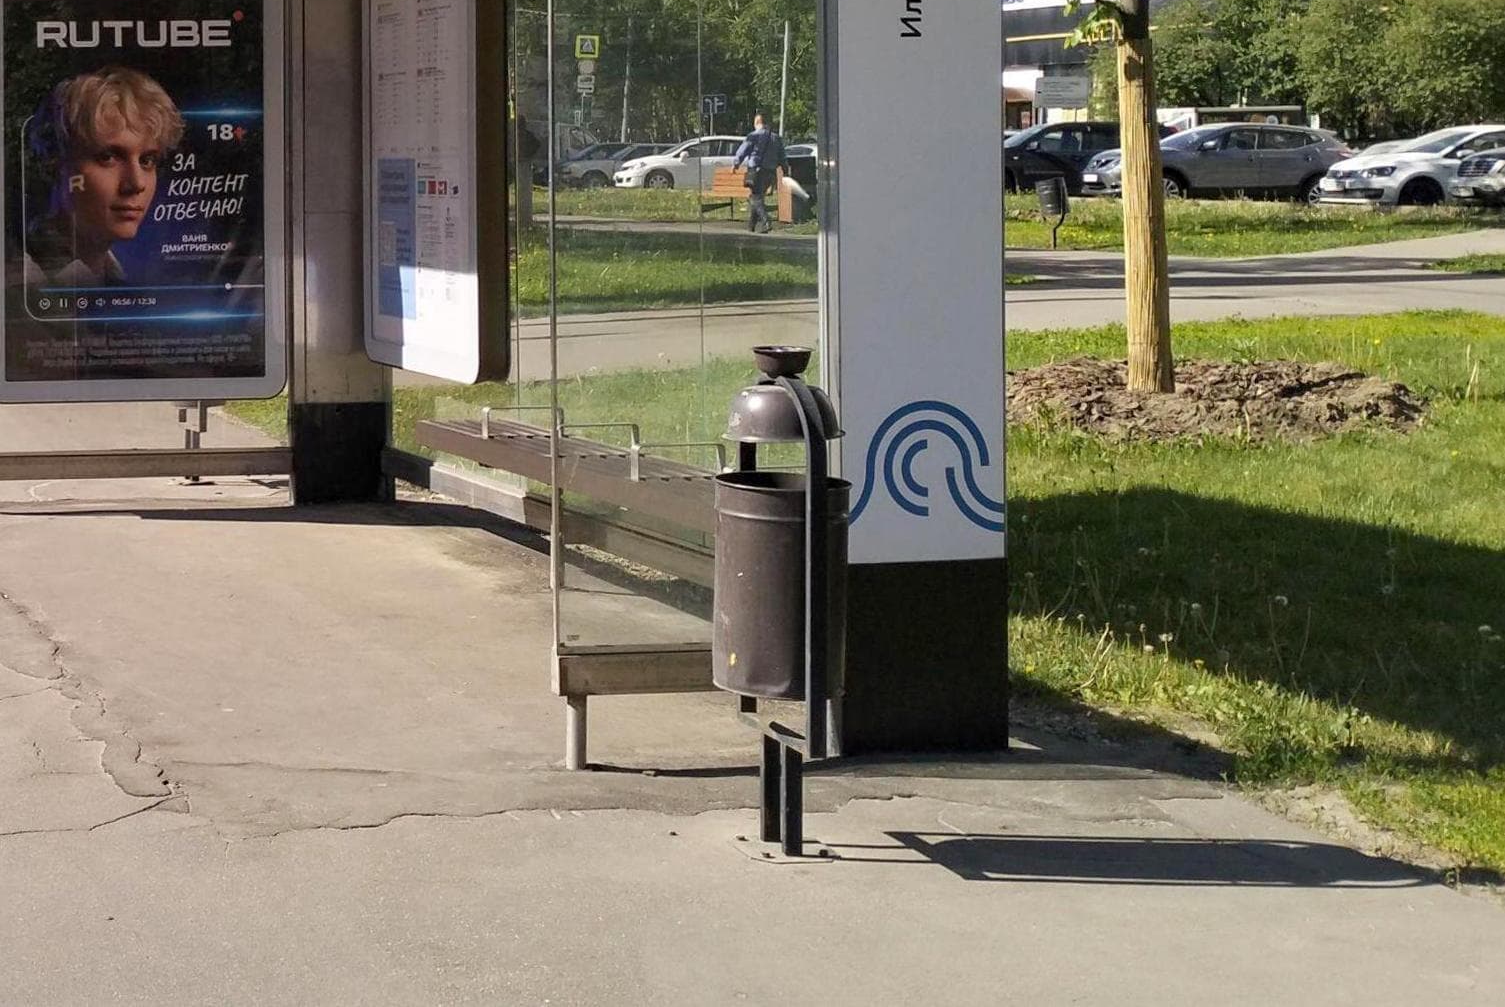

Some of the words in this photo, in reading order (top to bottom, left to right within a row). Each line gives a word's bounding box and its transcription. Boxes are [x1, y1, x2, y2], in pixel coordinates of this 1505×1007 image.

[36, 19, 232, 49] RUTUBE
[171, 153, 196, 172] ЗА
[167, 173, 248, 197] КОНТЕНТ
[154, 196, 244, 221] ОТВЕЧАЮ!
[160, 242, 228, 253] ДМИТРИЕНКО
[181, 234, 208, 243] ВАНЯ
